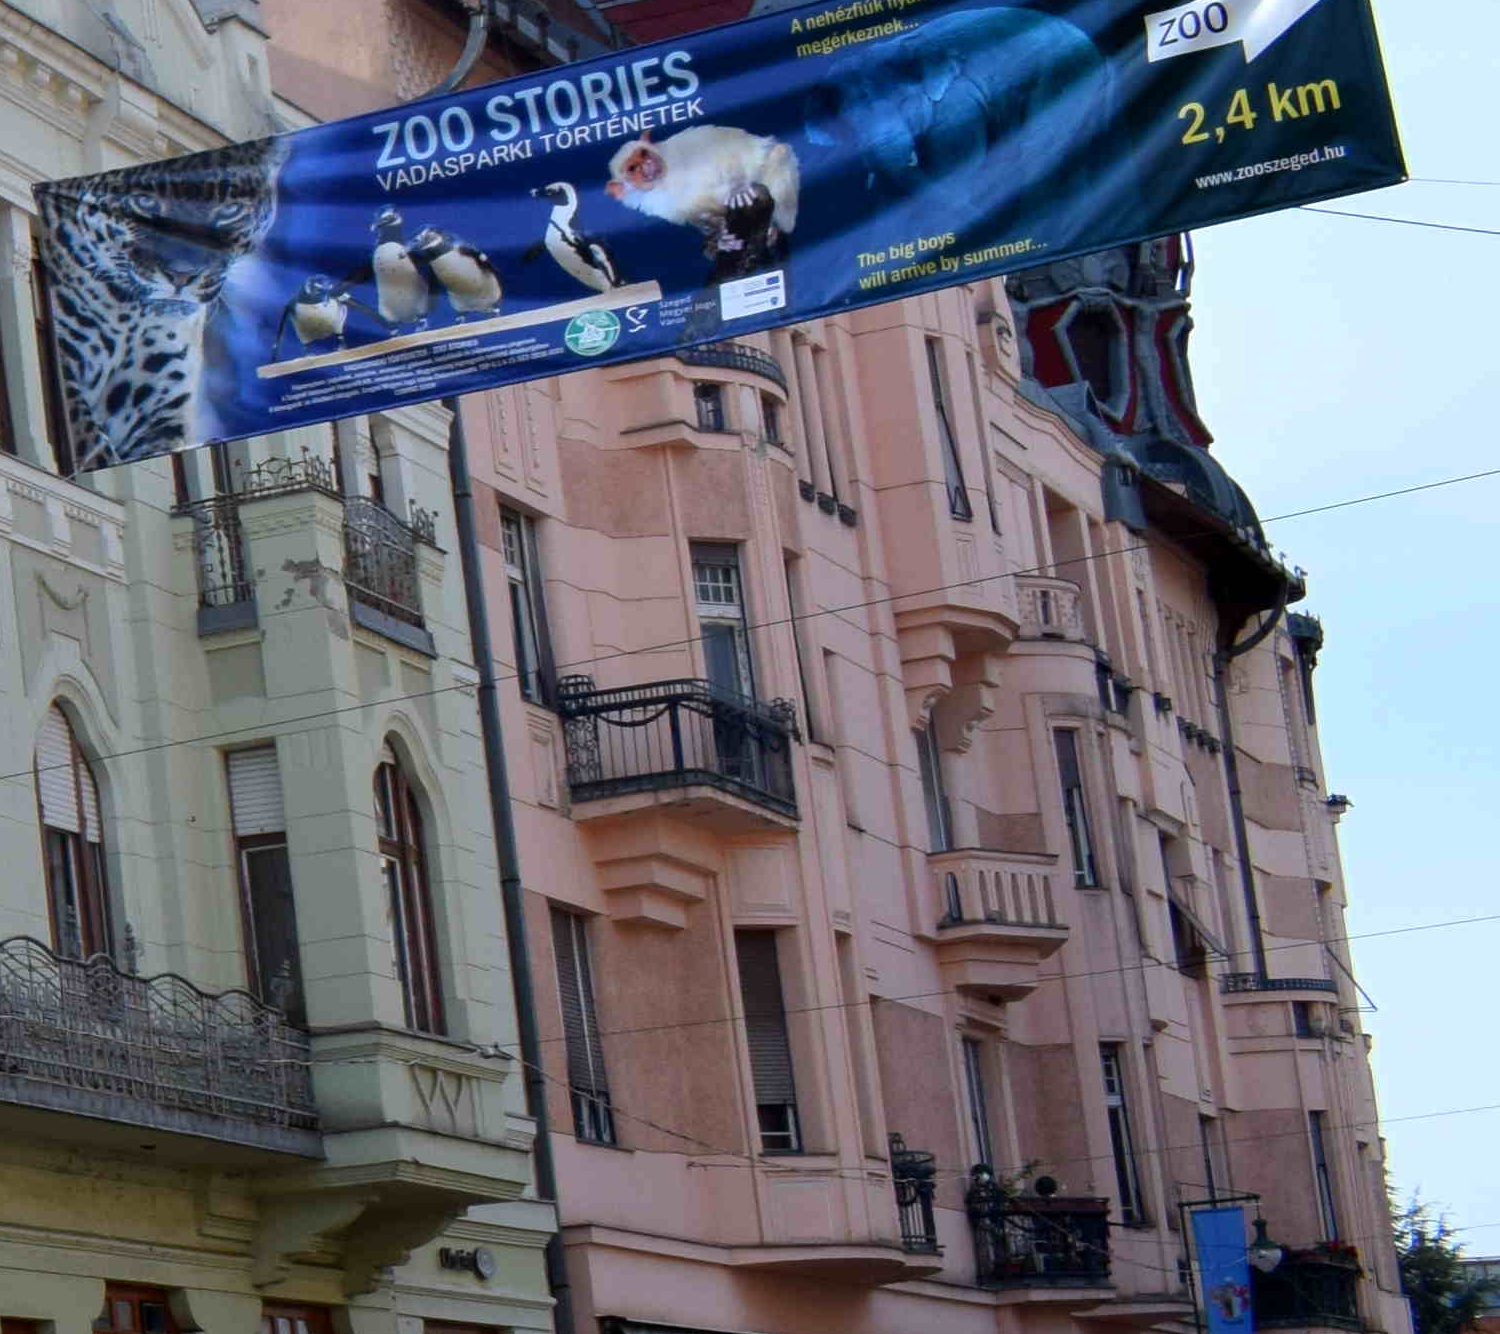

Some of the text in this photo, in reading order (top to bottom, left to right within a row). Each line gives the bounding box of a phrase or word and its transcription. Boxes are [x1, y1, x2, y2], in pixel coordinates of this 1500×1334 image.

[791, 18, 803, 34] A
[796, 18, 919, 58] megérkeznek...
[1158, 2, 1229, 47] ZOO
[372, 50, 700, 169] ZOO STORIES
[1177, 78, 1341, 145] 2,4 km
[376, 97, 704, 192] VADASPARKI TÖRTÉNETEK
[1194, 145, 1346, 189] www.zooszeged.hu
[857, 232, 956, 268] The big boys
[859, 237, 1049, 290] will arrive by summer...
